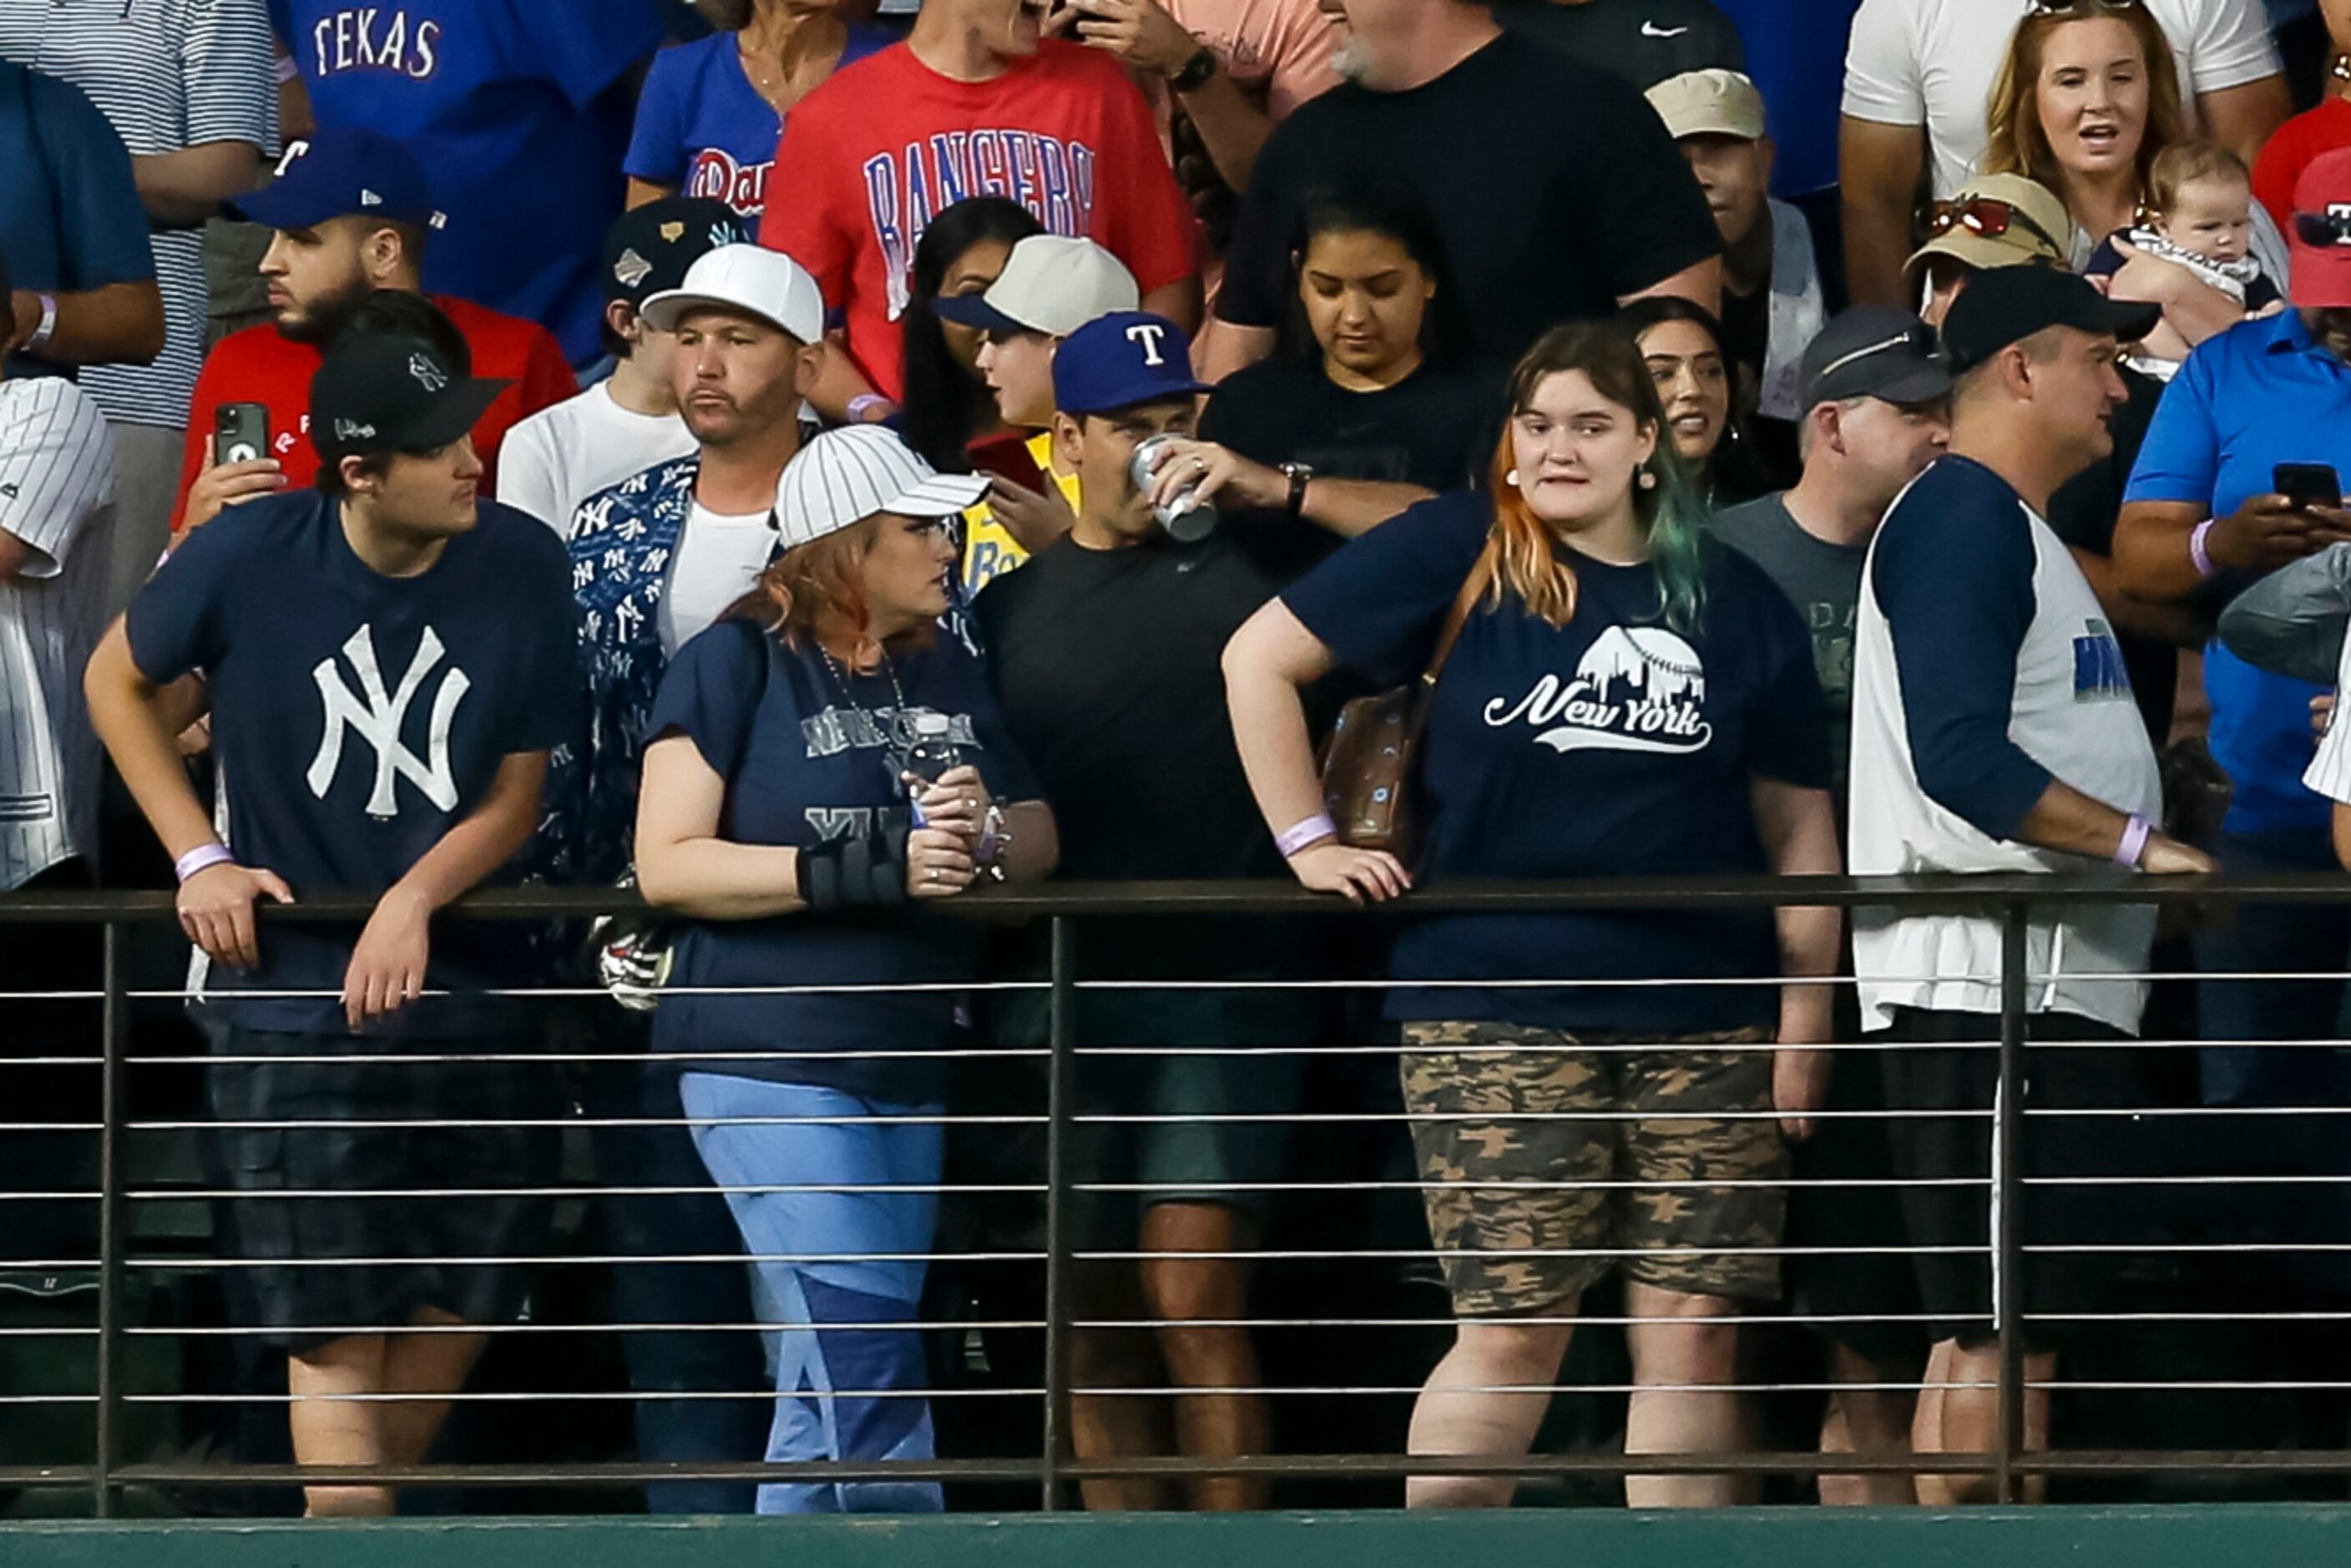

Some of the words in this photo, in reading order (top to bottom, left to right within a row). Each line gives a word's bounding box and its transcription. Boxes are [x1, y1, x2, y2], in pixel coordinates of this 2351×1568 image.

[2328, 204, 2351, 244] T
[1125, 325, 1165, 366] T
[306, 623, 471, 816] NY
[1484, 674, 1620, 727] New
[1624, 699, 1706, 736] York
